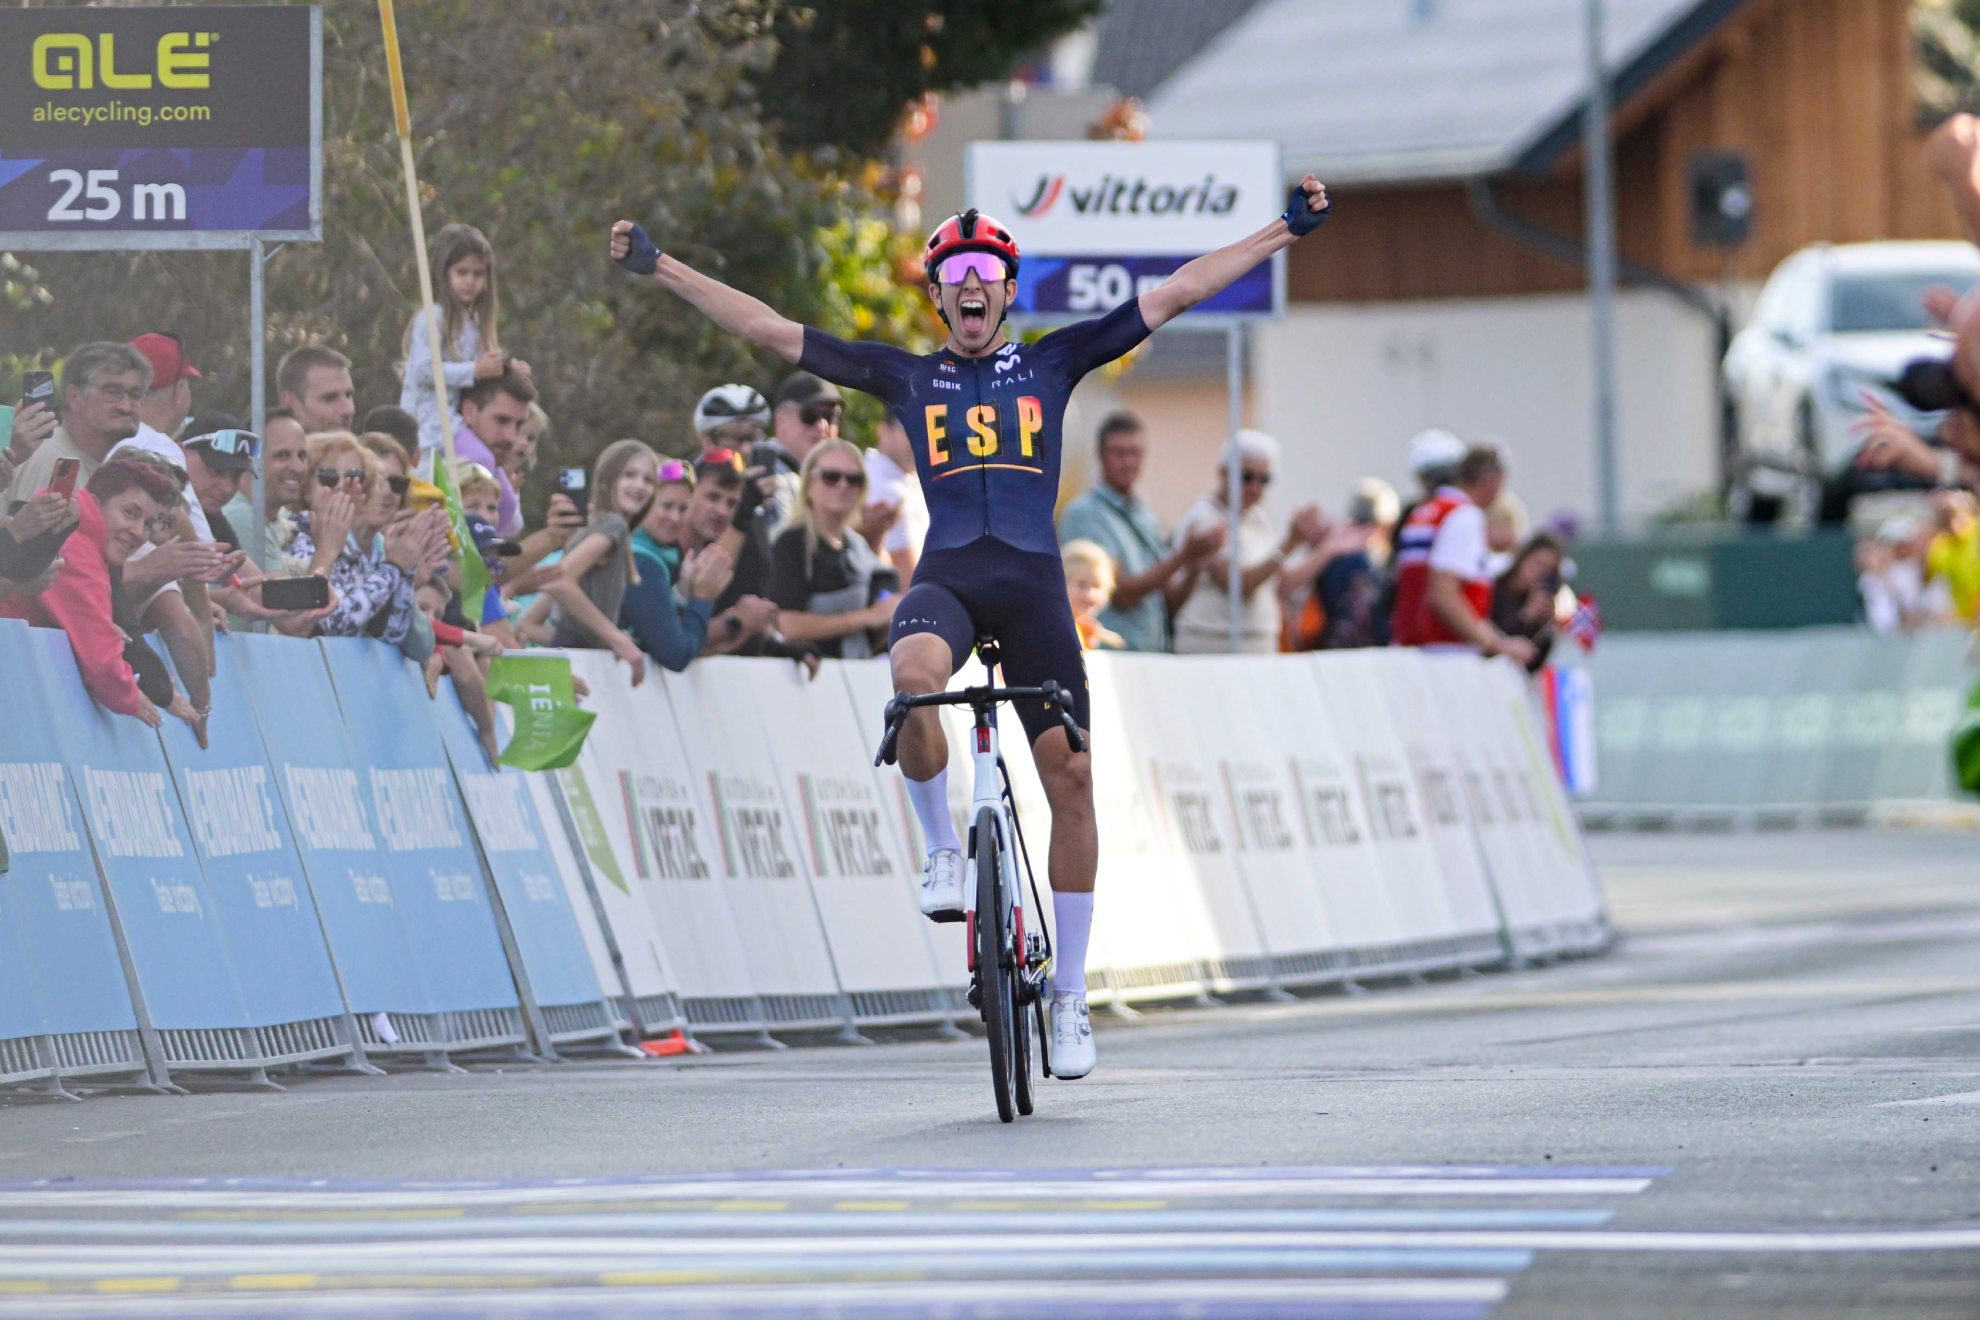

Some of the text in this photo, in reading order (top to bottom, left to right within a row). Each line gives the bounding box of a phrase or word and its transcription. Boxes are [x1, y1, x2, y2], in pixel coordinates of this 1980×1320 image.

[33, 101, 211, 126] alecycling.com
[47, 168, 187, 221] 25 m
[1069, 174, 1241, 215] vittoria
[1067, 263, 1134, 311] 50
[932, 378, 962, 391] GOBIK
[924, 395, 1043, 467] ESP
